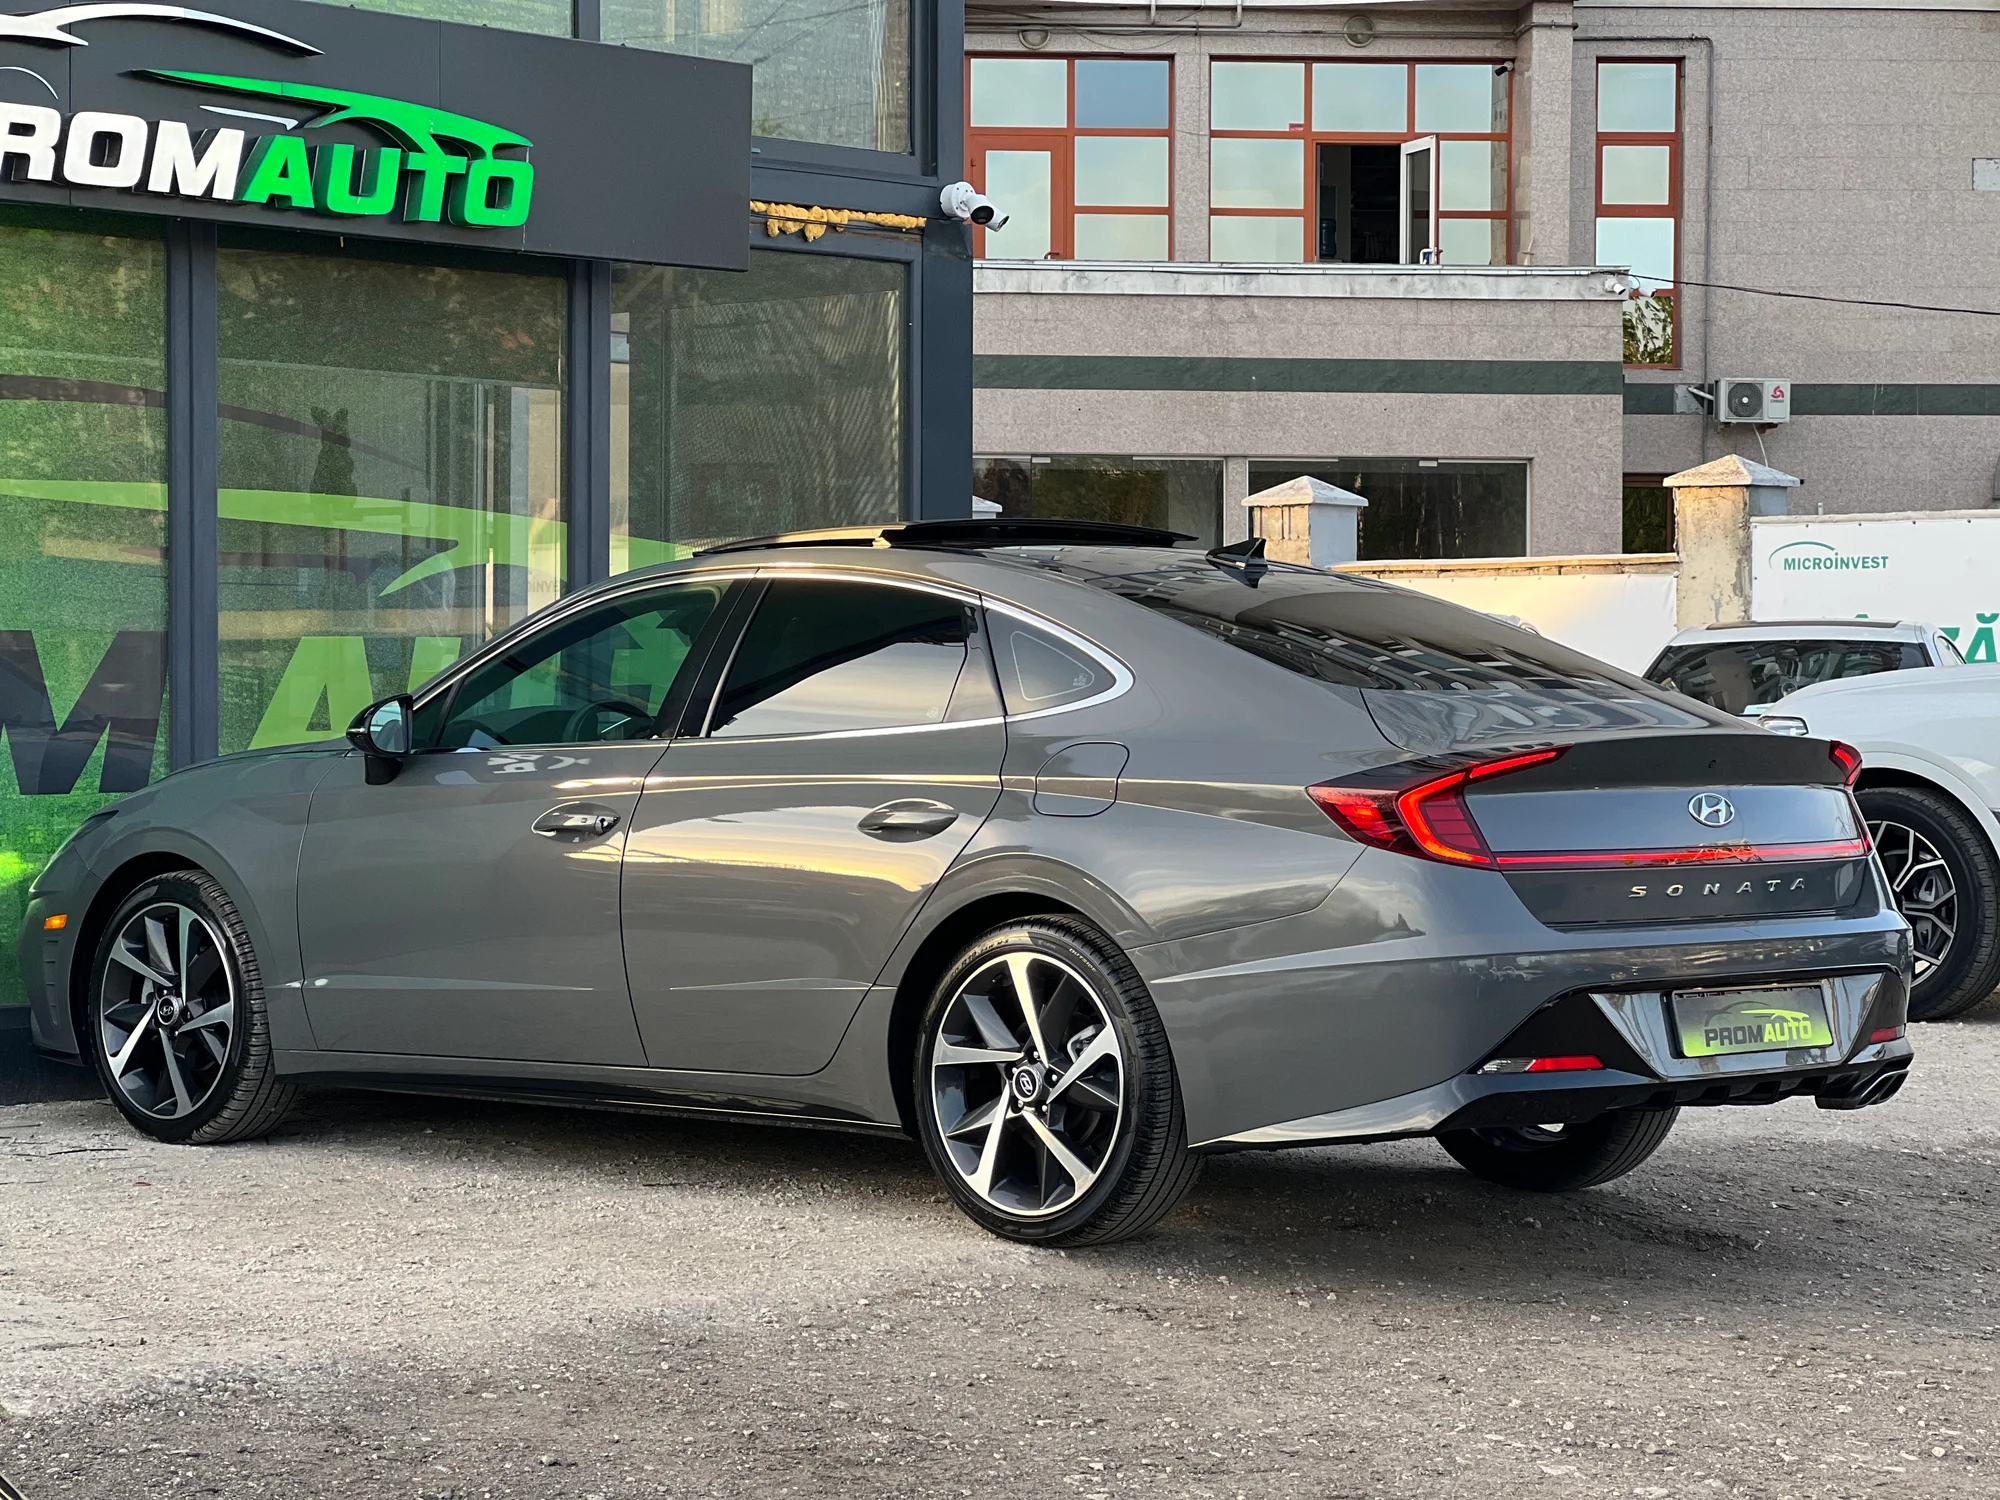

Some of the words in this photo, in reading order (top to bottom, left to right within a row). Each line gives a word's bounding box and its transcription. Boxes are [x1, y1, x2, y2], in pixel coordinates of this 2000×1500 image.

[1783, 553, 1889, 571] MICROINVEST
[1628, 878, 1805, 898] SONATA
[1704, 1020, 1813, 1048] PROMAUTO
